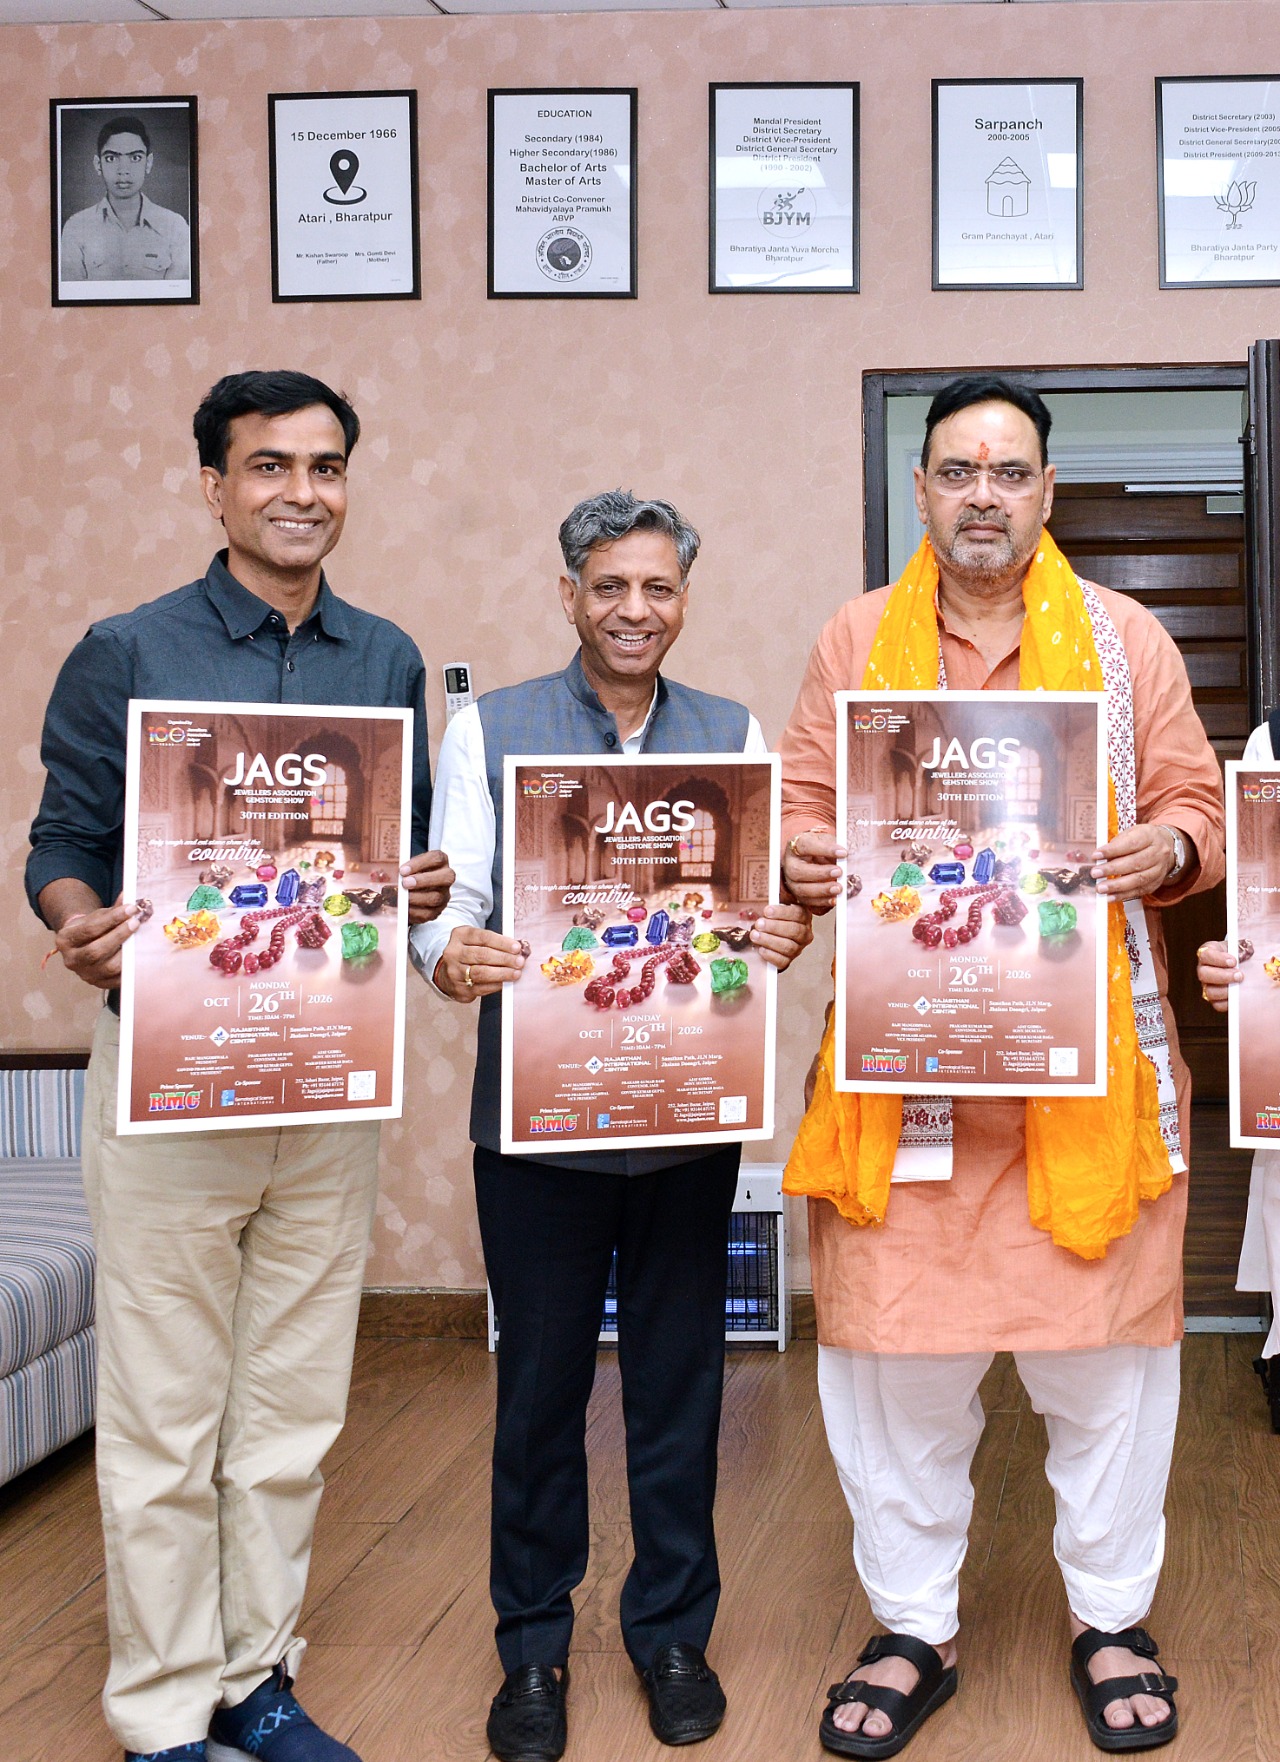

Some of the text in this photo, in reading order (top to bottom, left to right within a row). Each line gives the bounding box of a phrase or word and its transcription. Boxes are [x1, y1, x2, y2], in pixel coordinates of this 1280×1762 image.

[537, 110, 592, 118] EDUCATION
[974, 118, 1043, 133] Sarpanch
[291, 128, 397, 141] 15 December 1966
[783, 127, 822, 136] Secretary
[524, 134, 603, 144] Secondary (1984)
[773, 134, 831, 144] Vice-President
[509, 148, 618, 158] Higher Secondary(1986)
[735, 144, 765, 152] District
[799, 146, 838, 154] Secretary
[1209, 150, 1242, 159] President
[520, 163, 607, 172] Bachelor of Arts
[525, 176, 601, 186] Master of Arts
[515, 206, 574, 214] Mahavidyalaya
[298, 213, 326, 223] Atari
[335, 212, 393, 223] Bharatpur
[763, 212, 810, 226] BJYM
[985, 233, 1028, 241] Panchayat
[729, 245, 766, 254] Bharatiya
[1190, 244, 1230, 253] Bharatiya
[1256, 244, 1278, 252] Party
[765, 254, 803, 263] Bharatpur
[1214, 252, 1255, 261] Bharatpur
[921, 737, 1021, 770] JAGS
[223, 752, 327, 787] JAGS
[937, 793, 962, 801] 30TH
[240, 812, 309, 820] 30TH EDITION
[595, 800, 695, 834] JAGS
[638, 856, 678, 864] EDITION
[907, 969, 931, 978] OCT
[1006, 970, 1031, 979] 2026
[204, 998, 230, 1007] OCT
[307, 995, 332, 1003] 2026
[579, 1030, 603, 1039] OCT
[678, 1026, 703, 1035] 2026
[862, 1055, 907, 1073] RMC
[149, 1091, 202, 1111] RMC
[530, 1115, 578, 1133] RMC
